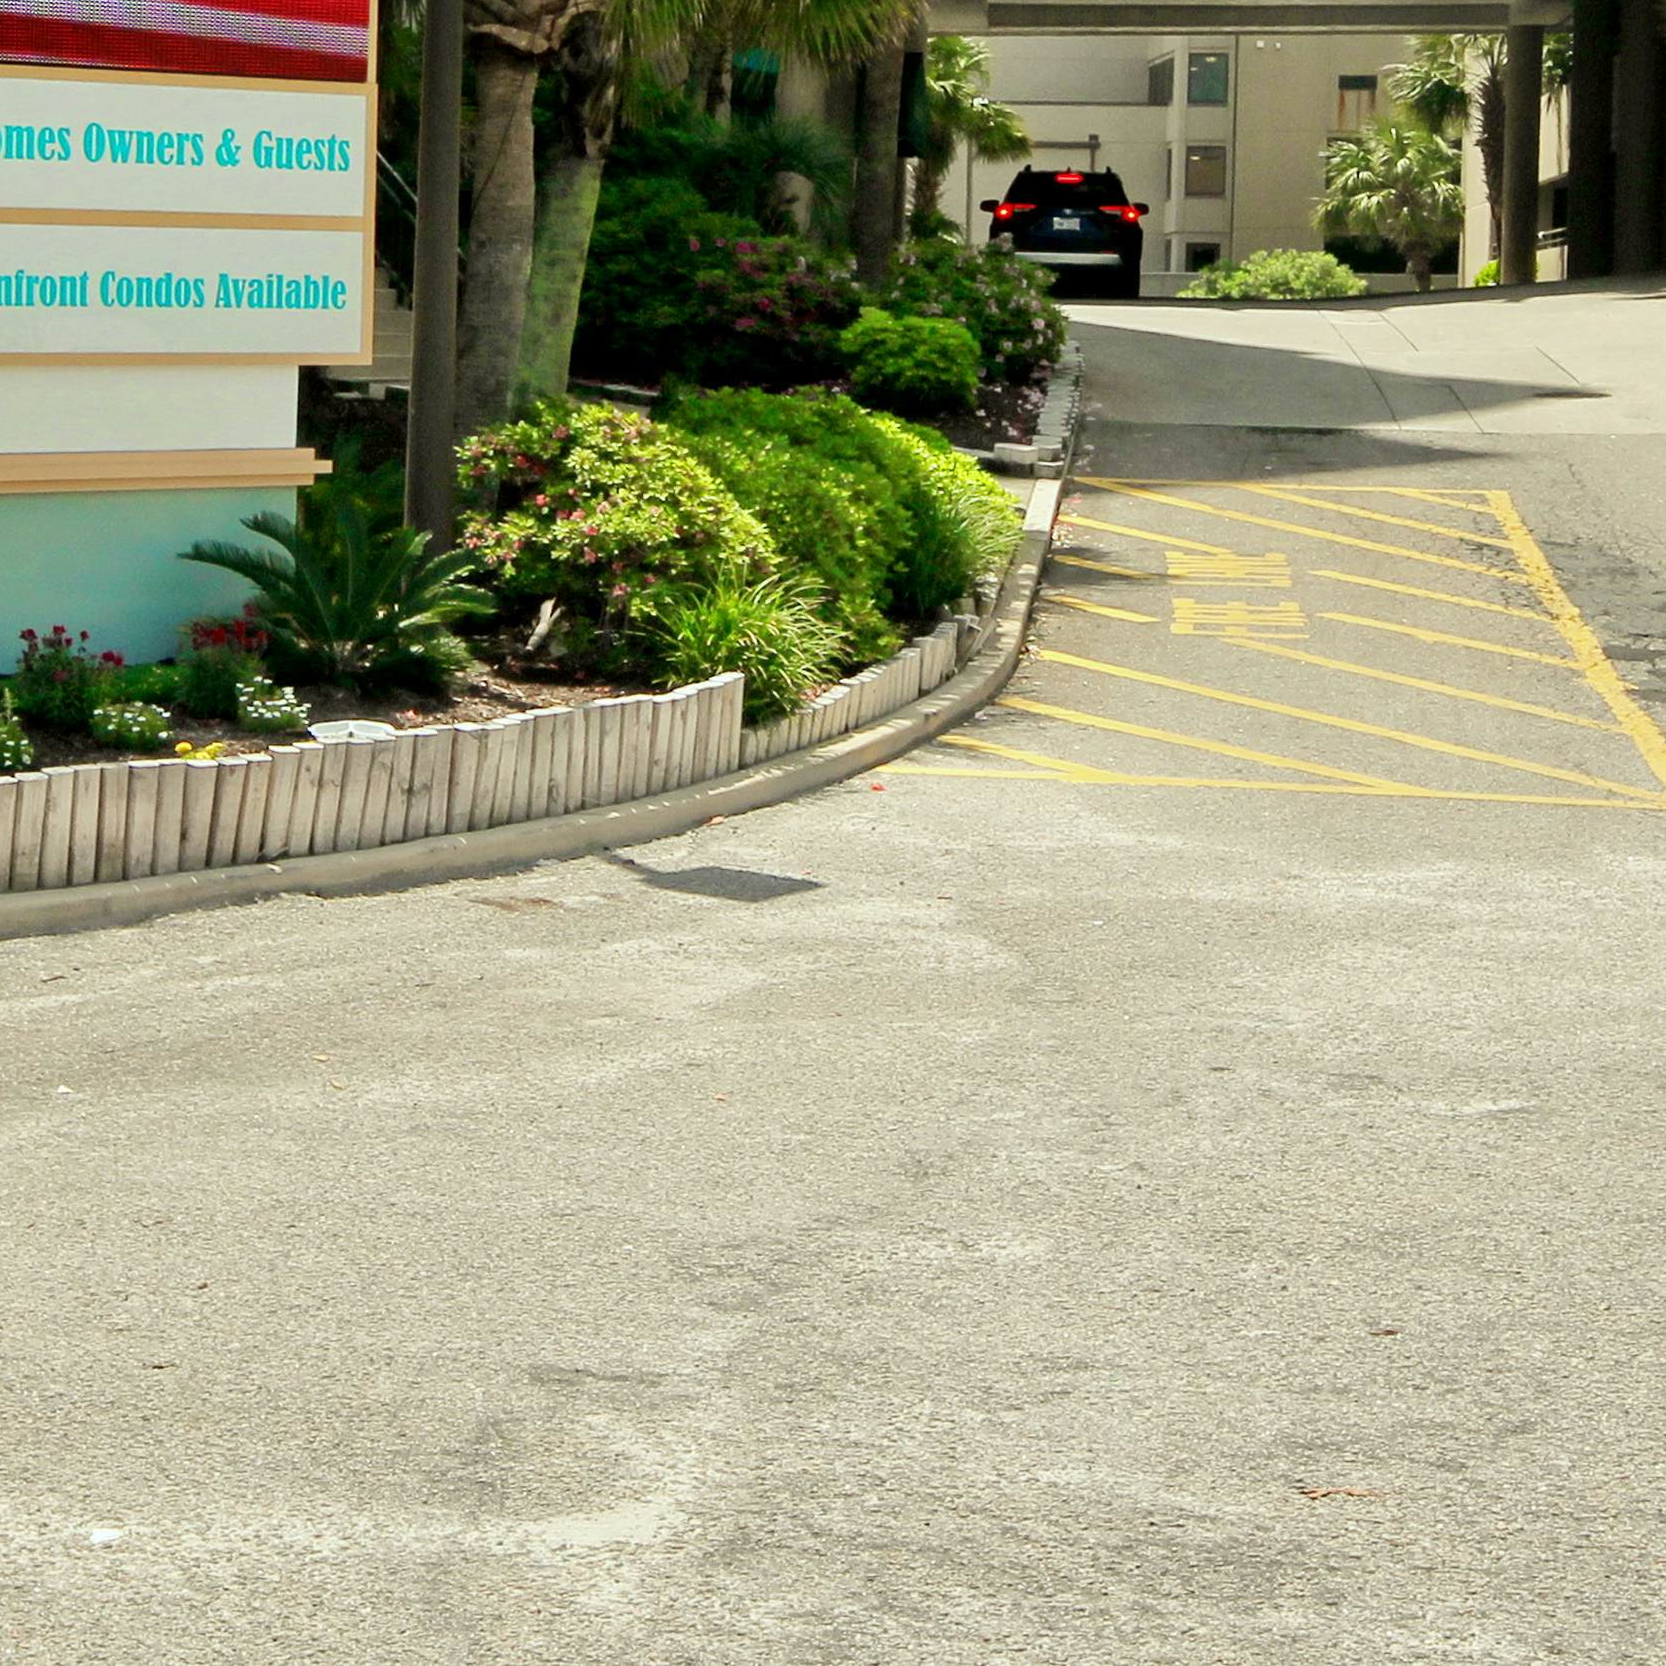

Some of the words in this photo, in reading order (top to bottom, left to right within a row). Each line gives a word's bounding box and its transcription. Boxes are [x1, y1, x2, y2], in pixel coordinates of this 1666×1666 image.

[82, 121, 205, 167] Owners
[215, 127, 242, 167] &
[252, 129, 351, 172] Guests
[99, 270, 206, 309] Condos
[215, 272, 348, 310] Available
